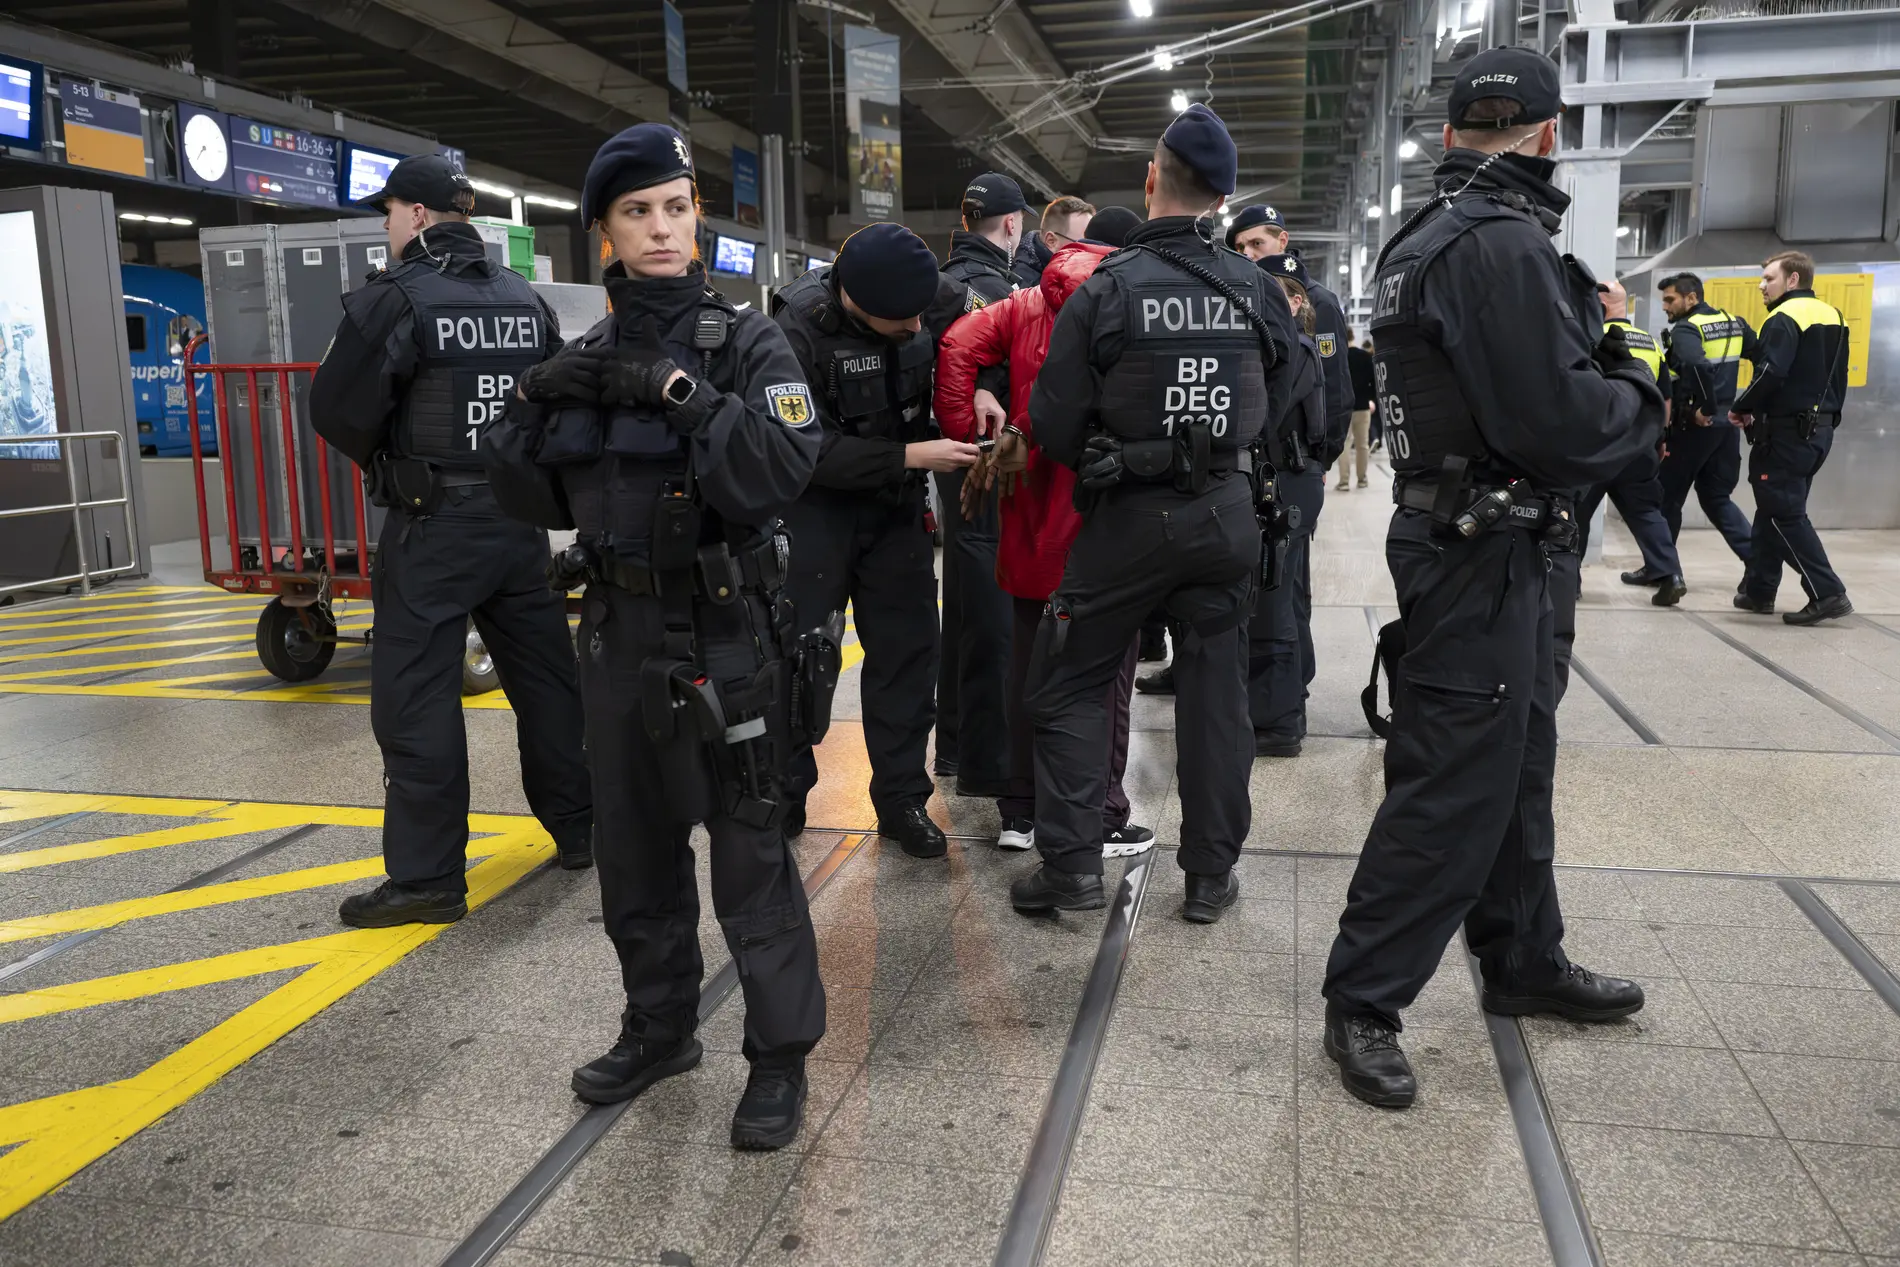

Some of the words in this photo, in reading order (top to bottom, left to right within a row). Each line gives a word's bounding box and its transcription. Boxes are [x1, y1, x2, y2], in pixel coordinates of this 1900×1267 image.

[72, 84, 89, 97] 5-13
[1471, 74, 1518, 88] POLIZEI
[249, 125, 260, 142] S
[262, 127, 272, 144] U
[296, 136, 324, 155] 16-36
[436, 316, 539, 350] POLIZEI
[1702, 324, 1713, 333] DB
[843, 356, 881, 374] POLIZEI
[1178, 357, 1219, 383] BP
[477, 374, 514, 398] BP
[770, 386, 806, 397] POLIZEI
[1164, 385, 1230, 411] DEG
[467, 401, 505, 425] DE
[1509, 504, 1539, 519] POLIZEI
